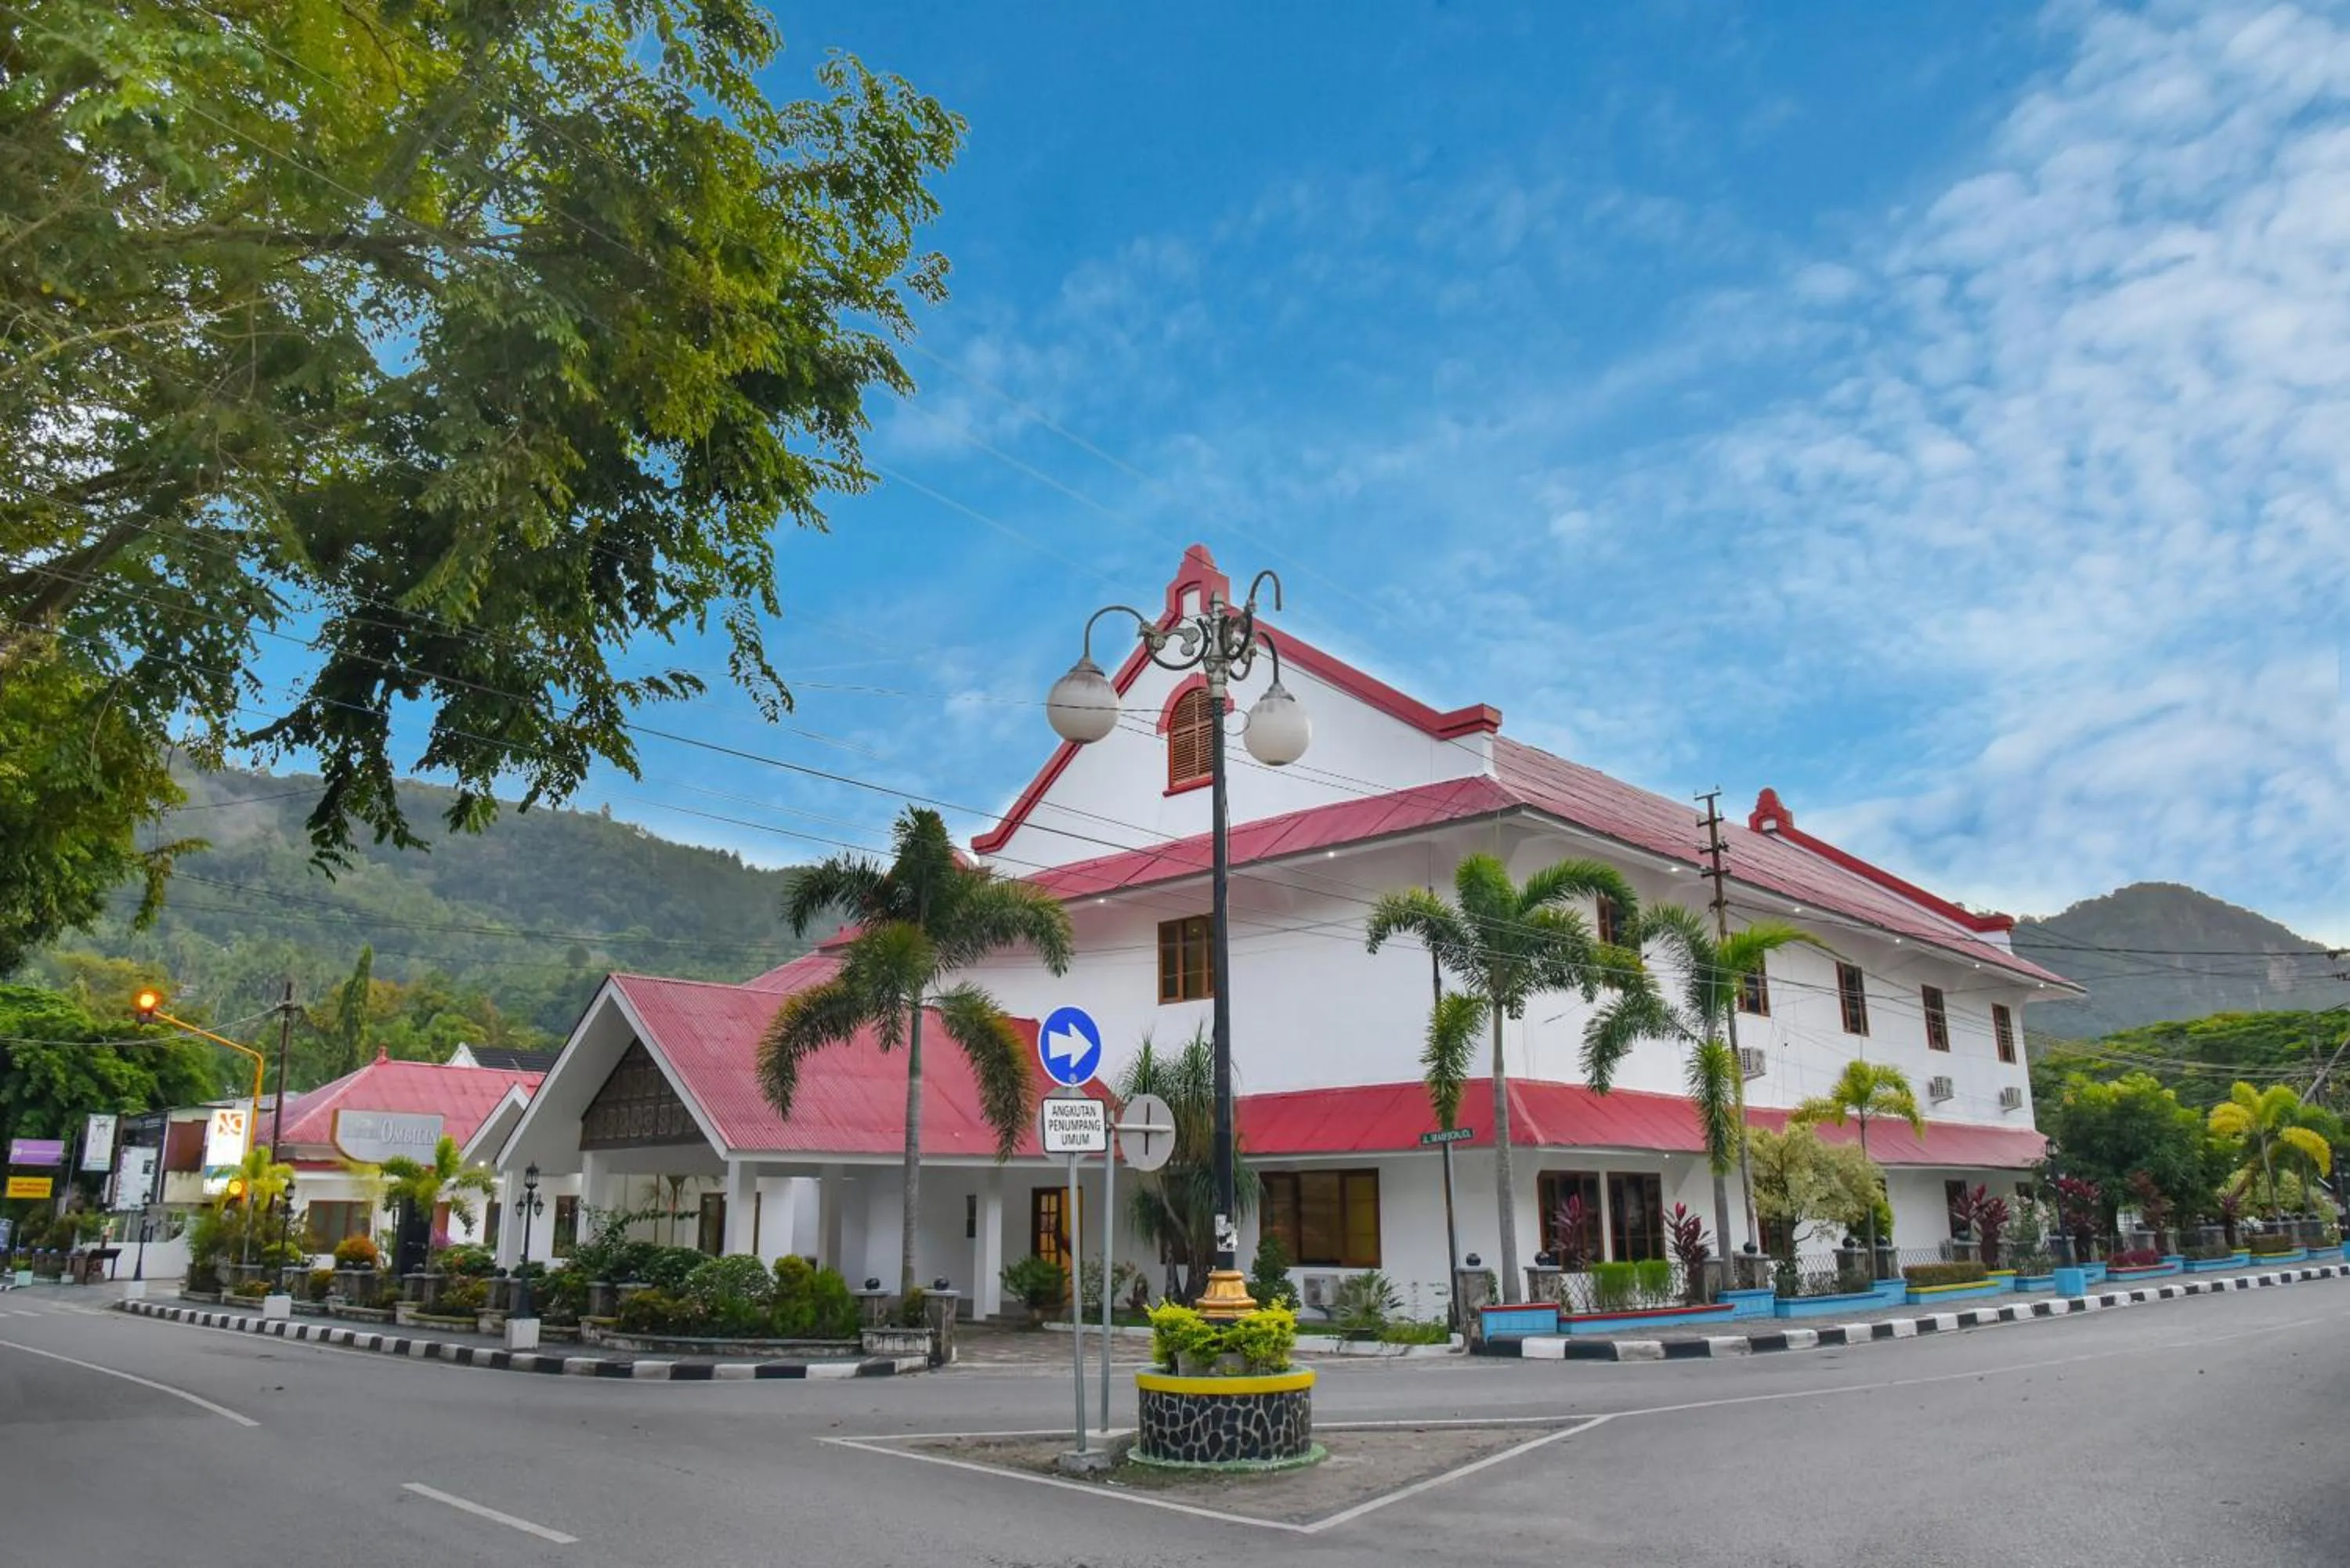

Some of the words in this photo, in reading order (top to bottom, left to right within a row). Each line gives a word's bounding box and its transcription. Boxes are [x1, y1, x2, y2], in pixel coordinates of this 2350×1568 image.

[1052, 1104, 1096, 1117] ANGKUTAN
[1048, 1118, 1101, 1132] PENUMPANG
[1061, 1133, 1090, 1146] UMUM
